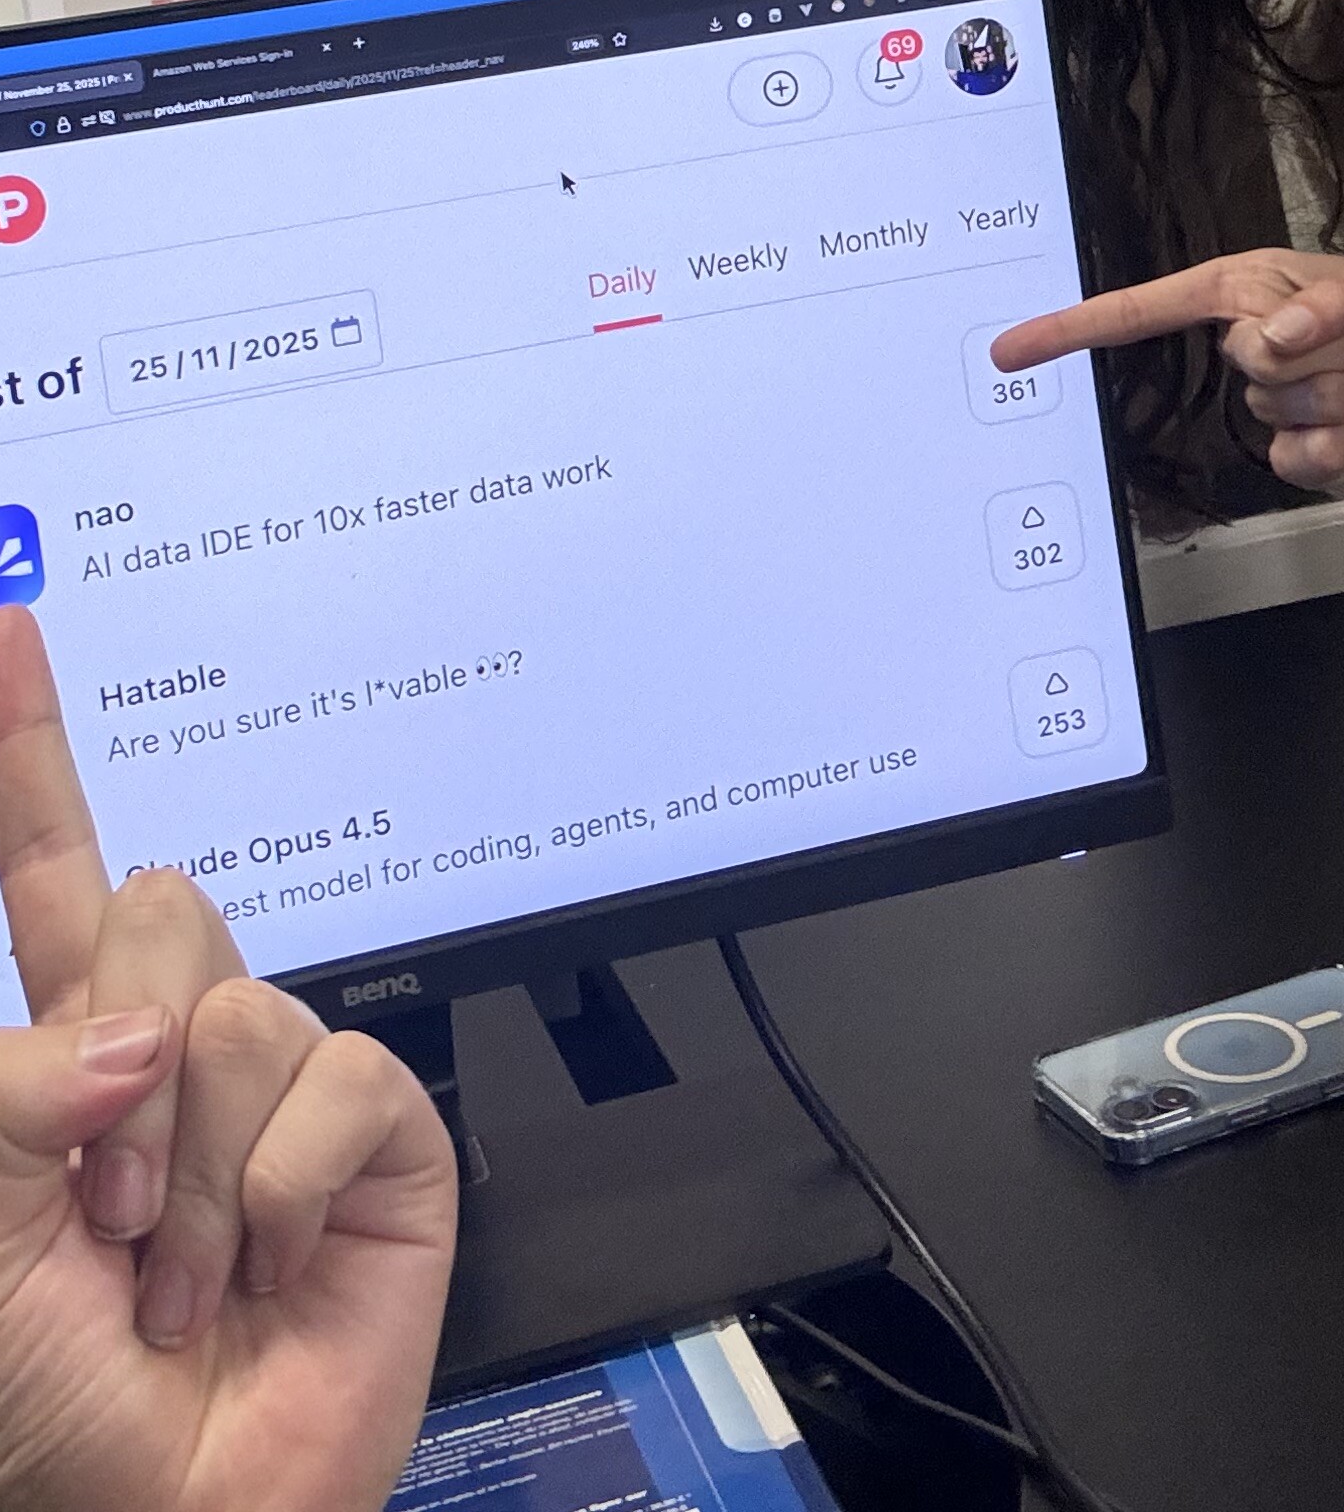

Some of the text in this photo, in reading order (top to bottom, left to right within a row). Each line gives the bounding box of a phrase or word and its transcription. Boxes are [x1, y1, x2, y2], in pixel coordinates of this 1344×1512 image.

[152, 48, 294, 78] Amazon Web Services Sign-in
[887, 37, 916, 57] 69
[3, 84, 55, 101] November
[74, 77, 101, 90] 2025
[588, 199, 1041, 299] Daily Weekly Monthly Yearly
[37, 357, 85, 401] of
[992, 377, 1038, 405] 361
[73, 500, 135, 533] nao
[82, 453, 613, 583] AI data IDE for 10x faster data work
[1013, 542, 1064, 572] 302
[99, 662, 228, 714] Hatable
[107, 728, 161, 764] Are
[169, 719, 227, 756] you
[235, 700, 303, 737] sure
[309, 684, 358, 721] it's
[1037, 708, 1087, 739] 253
[126, 809, 391, 879] ude Opus 4.5
[222, 744, 919, 922] est model for coding, agents, and computer use
[342, 972, 422, 1008] BenQ
